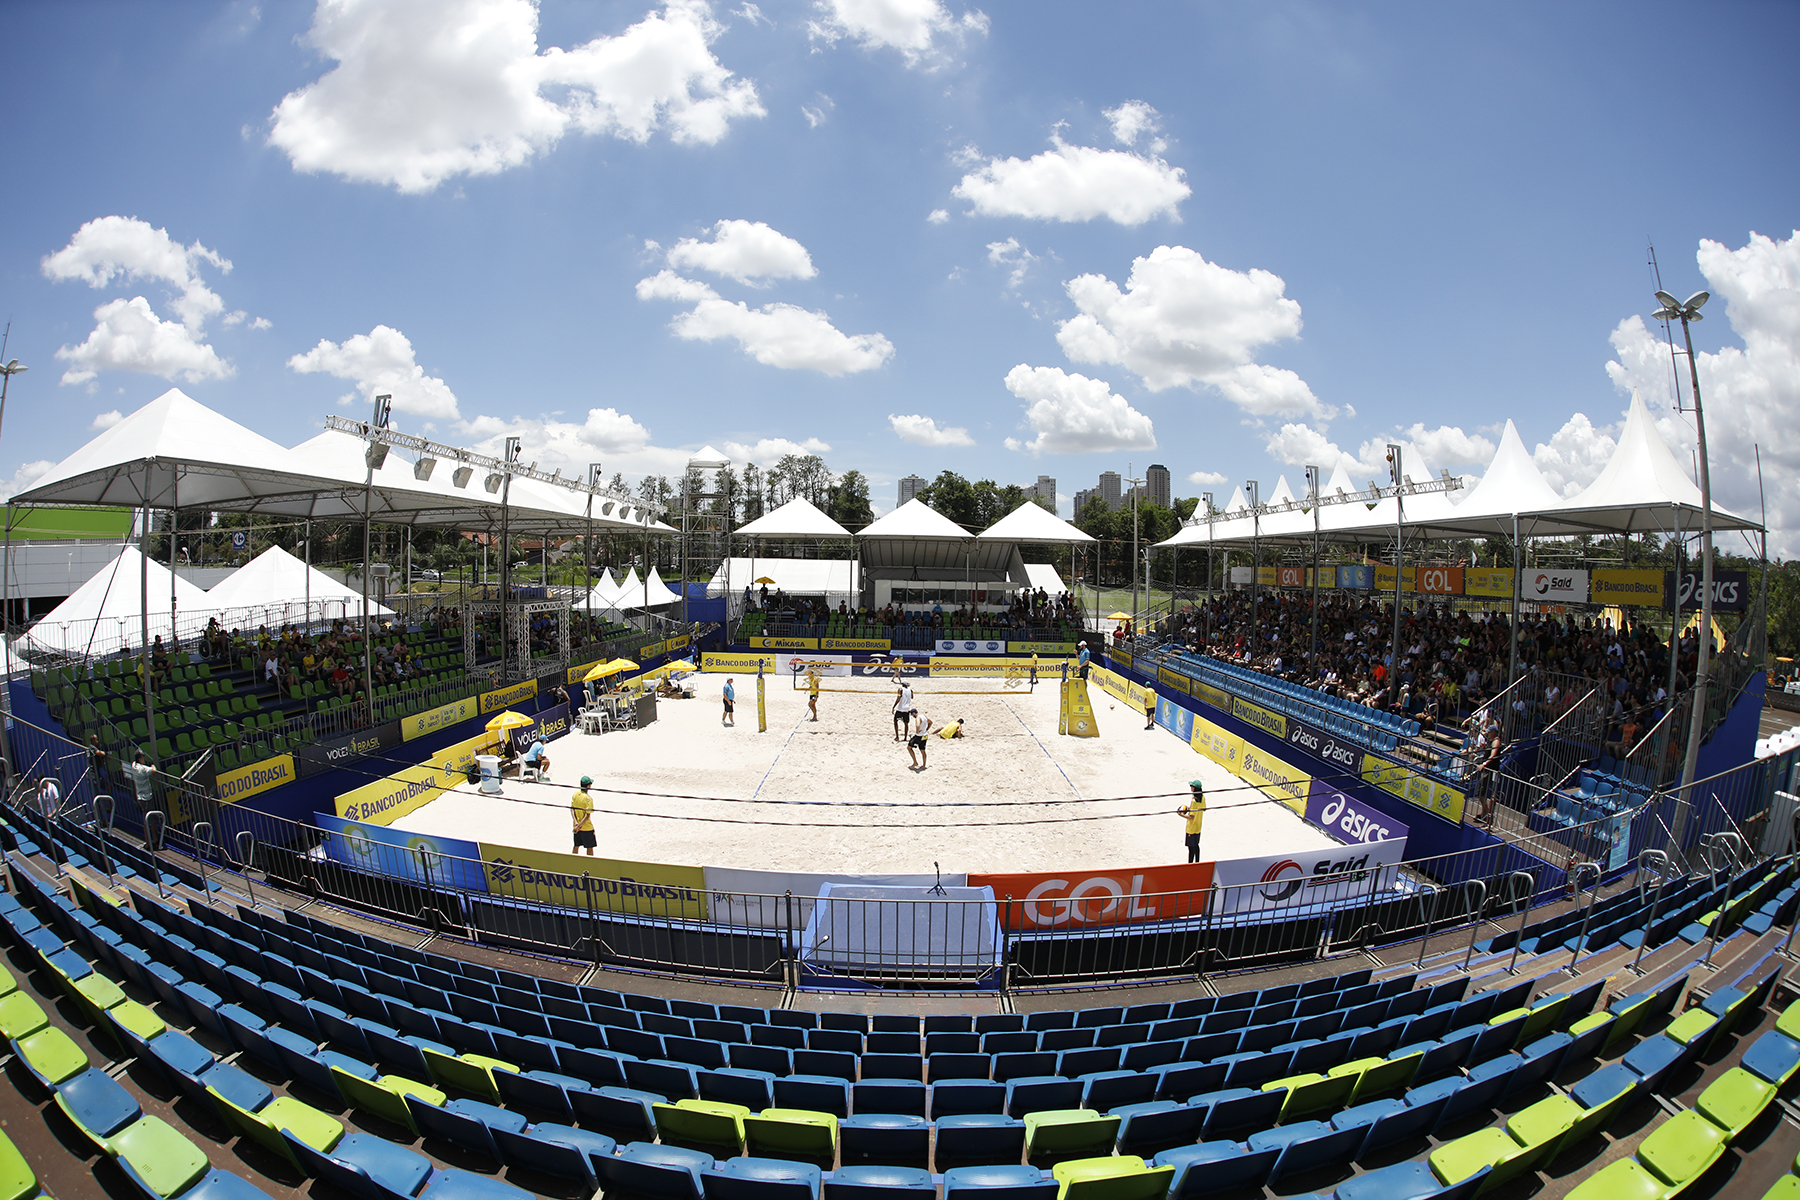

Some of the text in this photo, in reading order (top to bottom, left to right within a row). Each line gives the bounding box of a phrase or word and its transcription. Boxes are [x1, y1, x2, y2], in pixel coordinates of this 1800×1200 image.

[1282, 569, 1299, 585] GOL
[1424, 570, 1452, 591] GOL
[1551, 577, 1572, 588] Said
[1604, 581, 1658, 594] BANCO DO BRASIL
[835, 640, 857, 648] BANCO
[866, 640, 886, 648] BRASIL
[715, 658, 738, 667] BANCO
[236, 775, 251, 793] DO
[251, 763, 288, 788] BRASIL
[1253, 759, 1274, 782] BANCO
[1412, 778, 1429, 792] Vai no
[361, 775, 437, 819] BANCO DO BRASIL
[1313, 854, 1369, 880] Said
[518, 864, 697, 901] BANCO DO BRASIL
[1024, 874, 1156, 926] GOL
